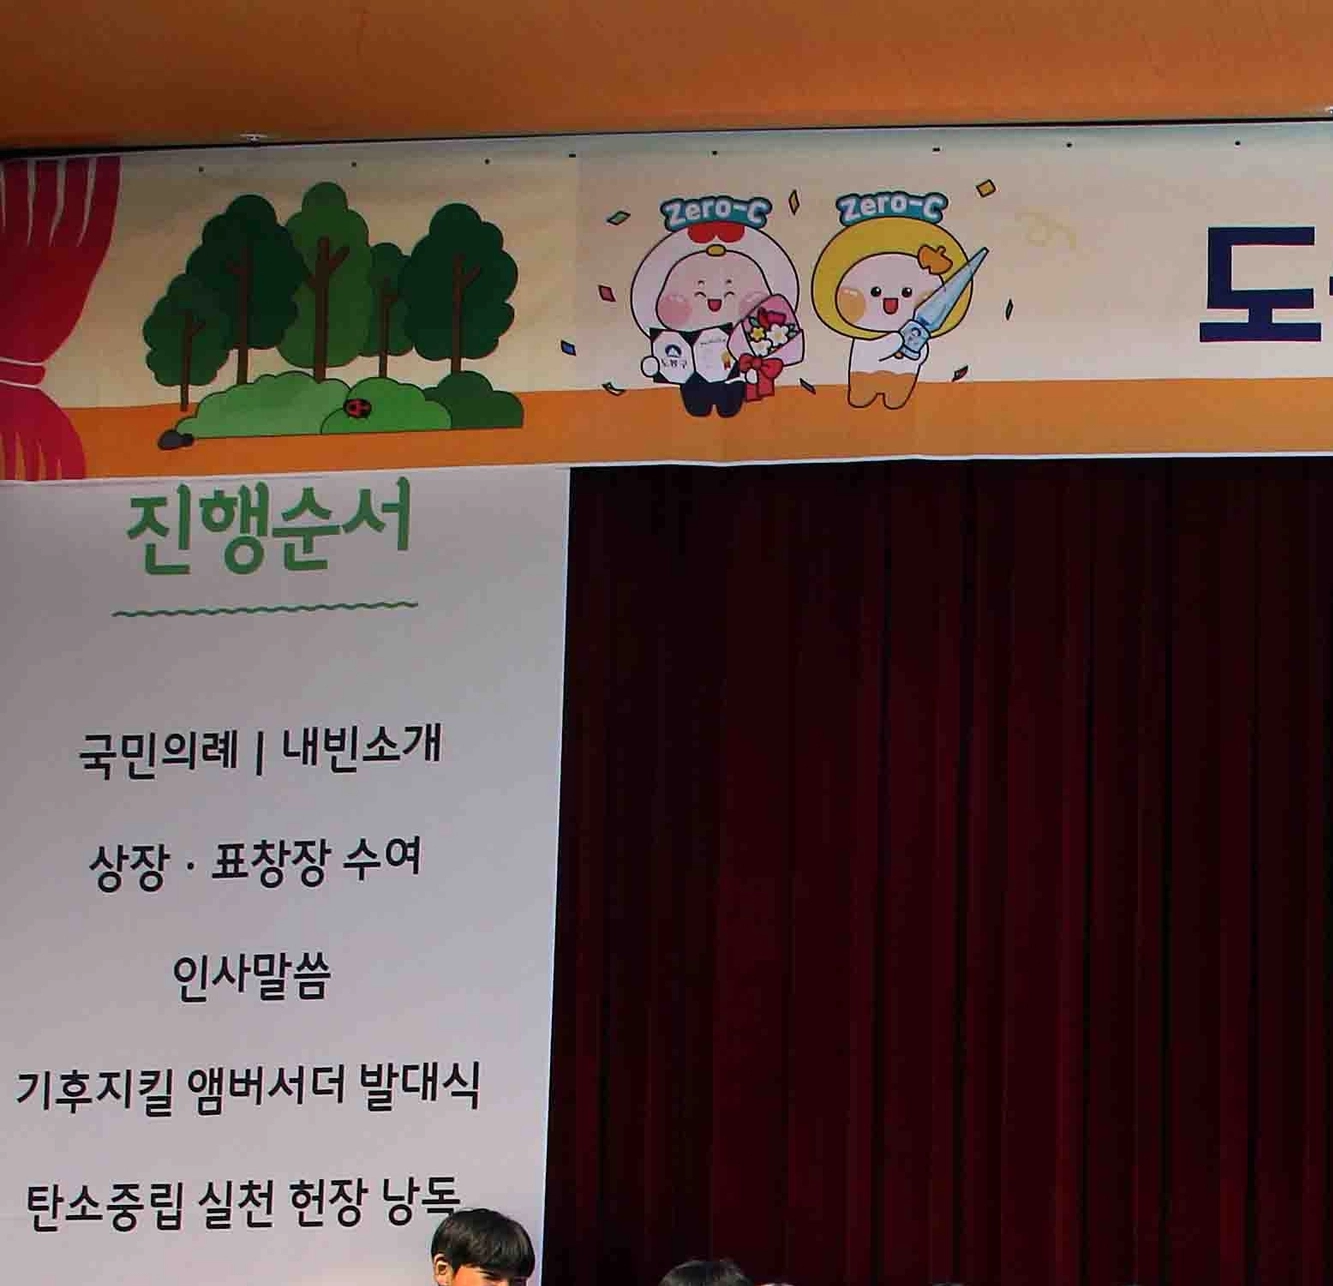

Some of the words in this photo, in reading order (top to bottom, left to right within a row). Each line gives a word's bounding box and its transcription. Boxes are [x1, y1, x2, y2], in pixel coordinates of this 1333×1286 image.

[664, 198, 768, 226] Zero-C
[840, 193, 944, 224] Zero-C
[126, 476, 411, 576] 진행순서
[78, 729, 238, 781] 국민의례
[283, 722, 441, 774] 내빈소개
[88, 843, 171, 894] 상장
[211, 838, 332, 889] 표창장
[342, 835, 421, 881] 수여
[173, 951, 332, 1003] 인사말씀
[16, 1068, 173, 1118] 기후지킬
[187, 1063, 345, 1116] 앰버서더
[360, 1060, 480, 1112] 발대식
[27, 1181, 183, 1233] 탄소중립
[198, 1179, 274, 1230] 실천
[289, 1177, 369, 1228] 헌장
[382, 1176, 461, 1227] 낭독
